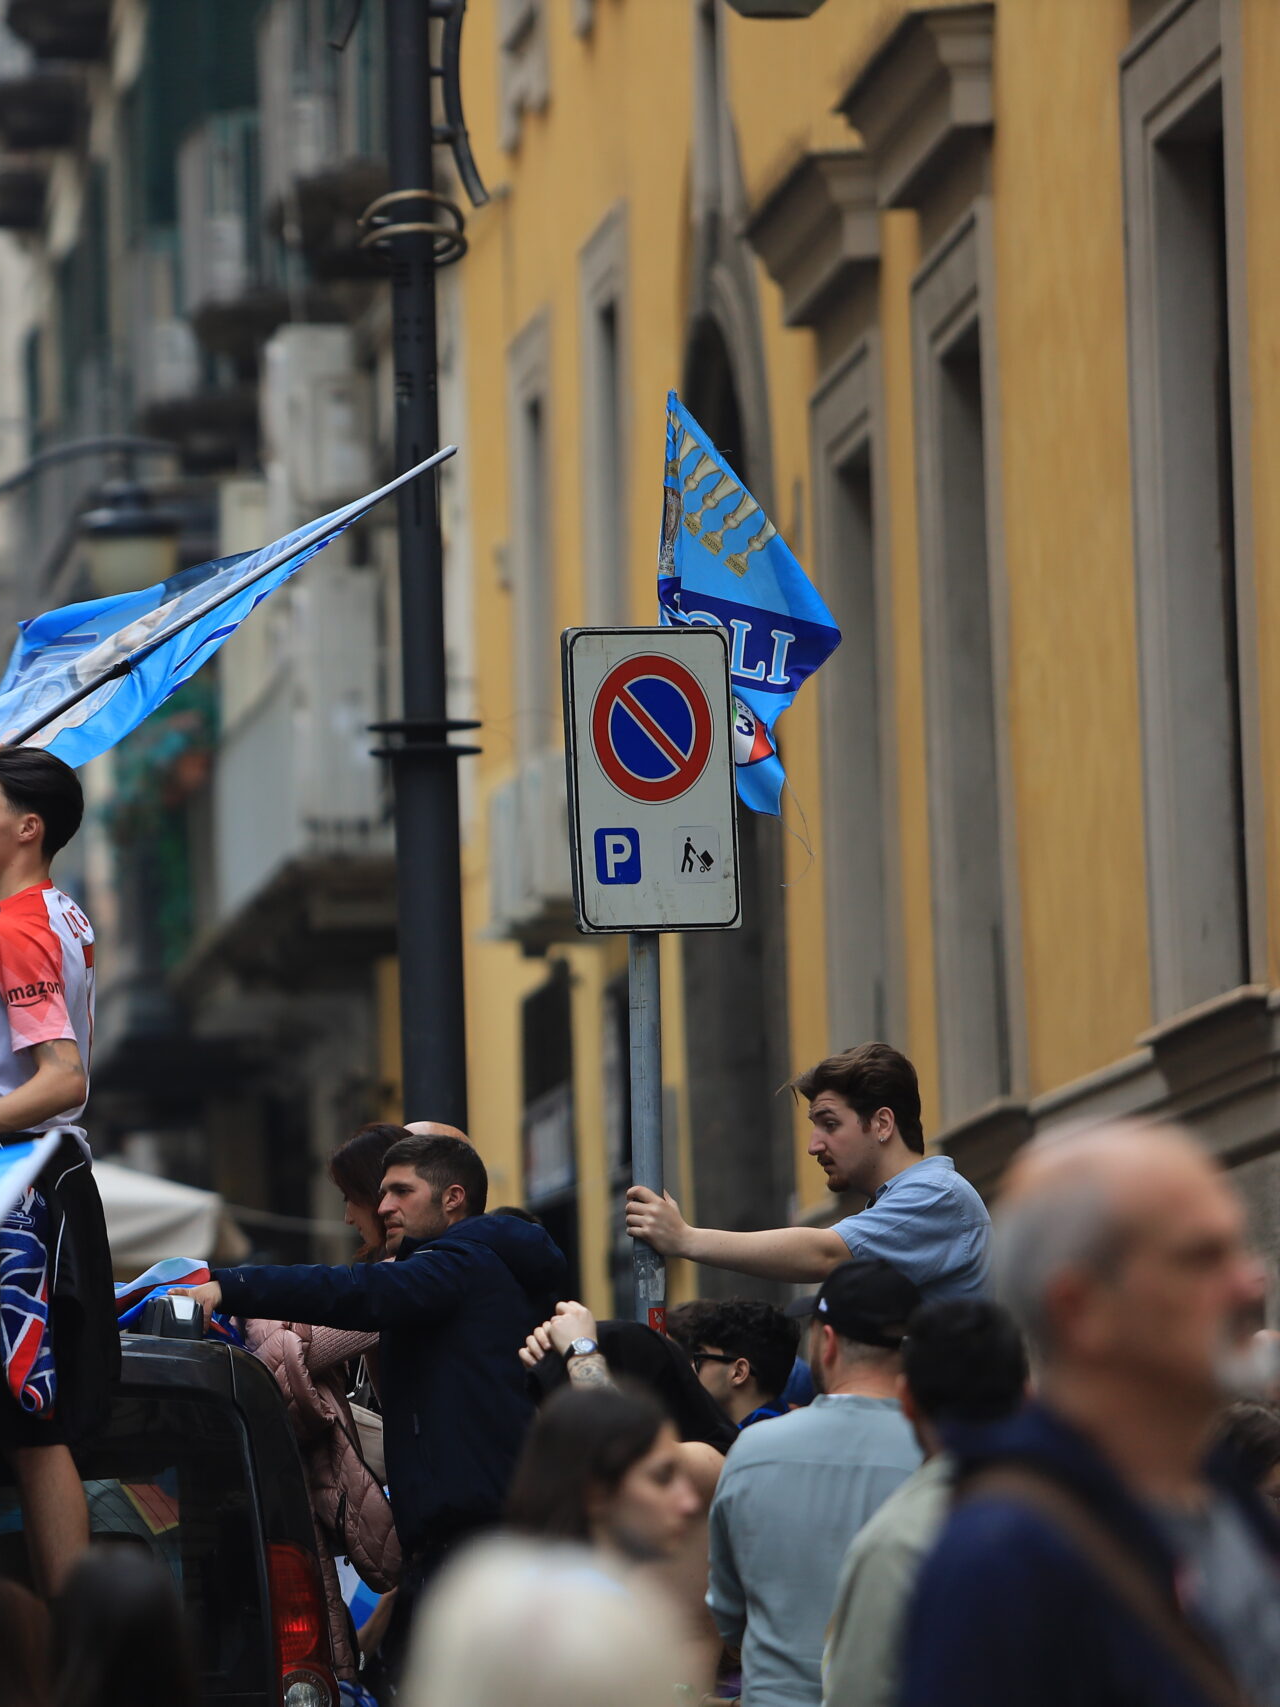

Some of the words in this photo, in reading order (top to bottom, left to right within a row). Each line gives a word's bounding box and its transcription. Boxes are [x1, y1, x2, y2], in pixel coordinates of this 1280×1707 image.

[736, 713, 755, 737] 3
[605, 834, 632, 878] P
[7, 980, 61, 1003] mazon
